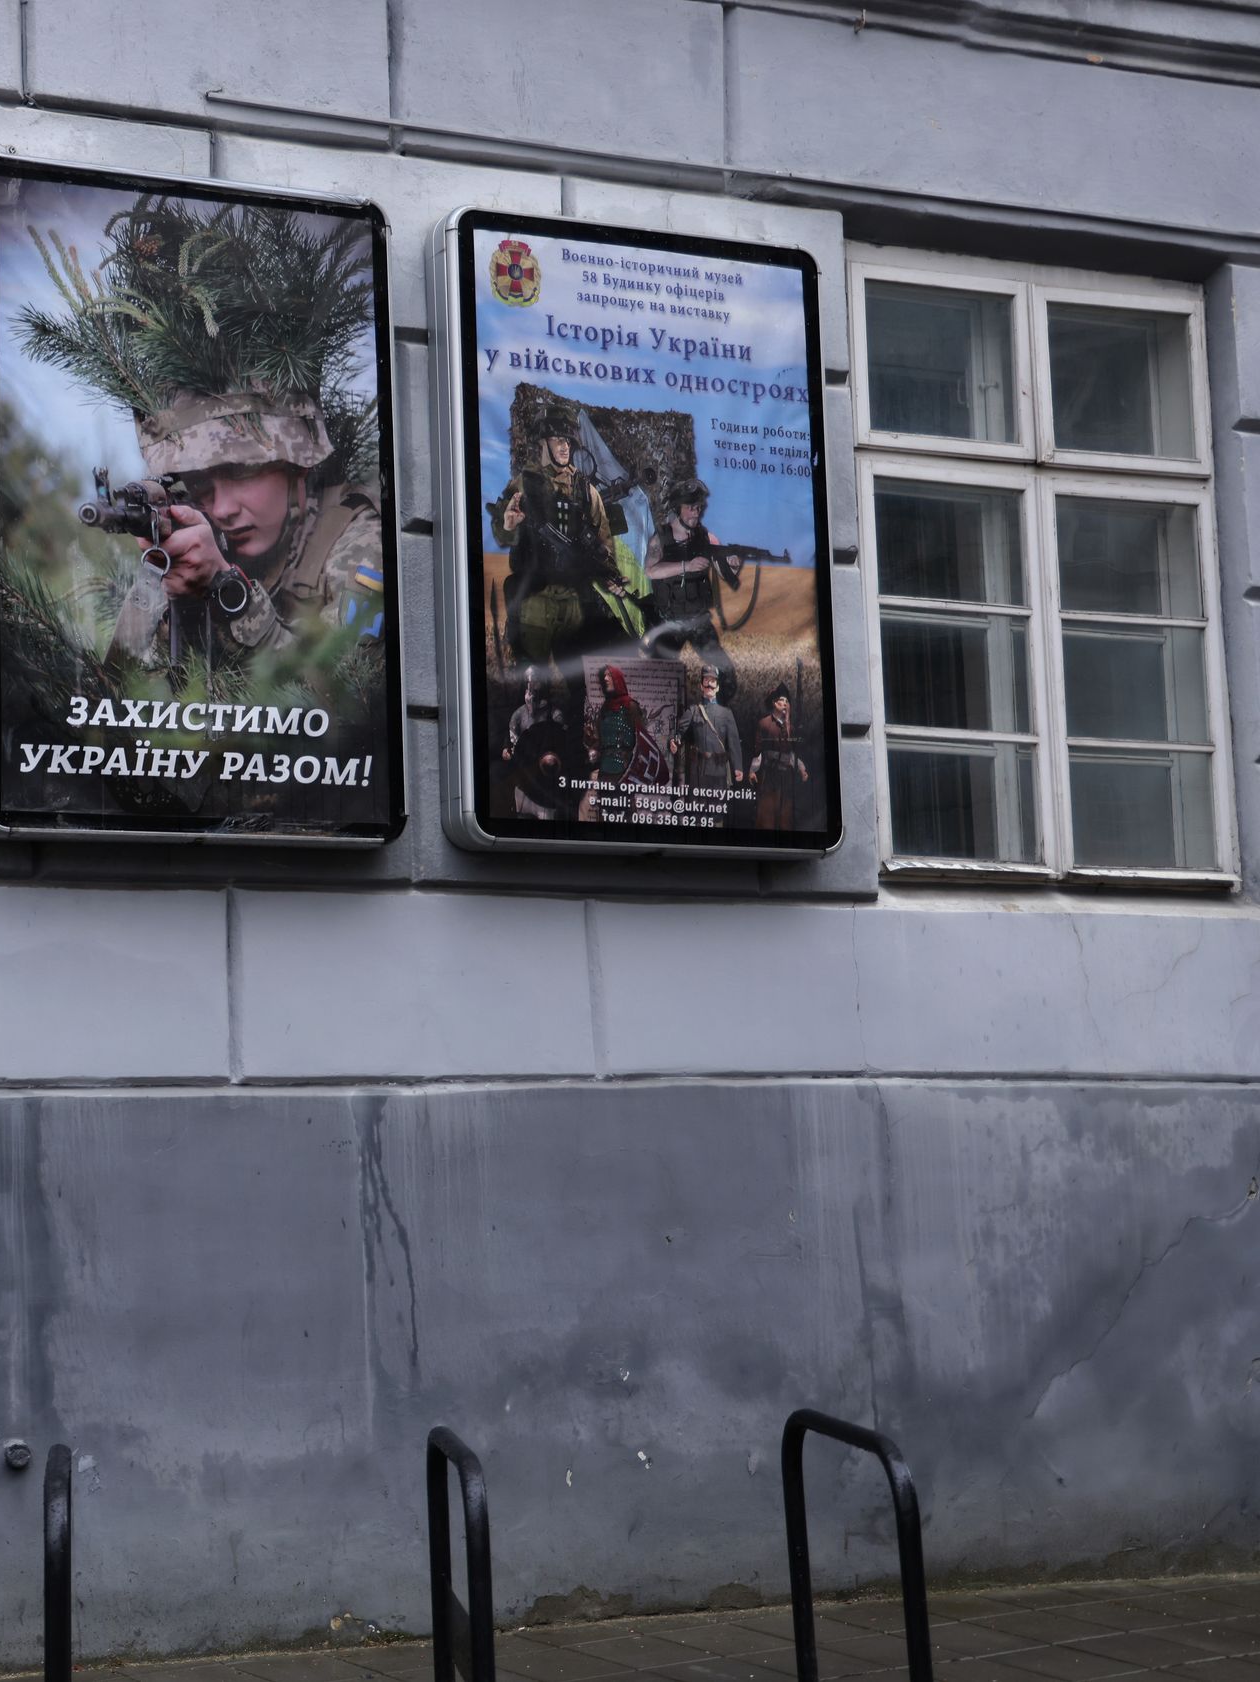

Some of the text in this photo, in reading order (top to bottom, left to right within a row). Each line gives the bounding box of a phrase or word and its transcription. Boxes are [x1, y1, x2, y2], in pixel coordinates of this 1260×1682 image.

[562, 248, 743, 286] Воєнно-історичний музей
[582, 270, 725, 303] 58 Будинку офіцерів
[576, 291, 730, 324] запрошує на виставку
[545, 314, 753, 362] Історія України
[484, 348, 809, 403] у військових одностроях
[711, 418, 810, 441] Години роботи:
[714, 439, 756, 455] четвер
[769, 446, 809, 459] неділя
[714, 457, 811, 478] з 10:00 до 16:00
[66, 696, 329, 738] ЗАХИСТИМО
[19, 739, 373, 787] УКРАЇНУ РАЗОМ!
[558, 776, 757, 801] З питань організації екскурсій:
[589, 796, 728, 814] e-mail: 58gbo@ukr.net
[602, 812, 714, 828] тел. 096 356 62 95
